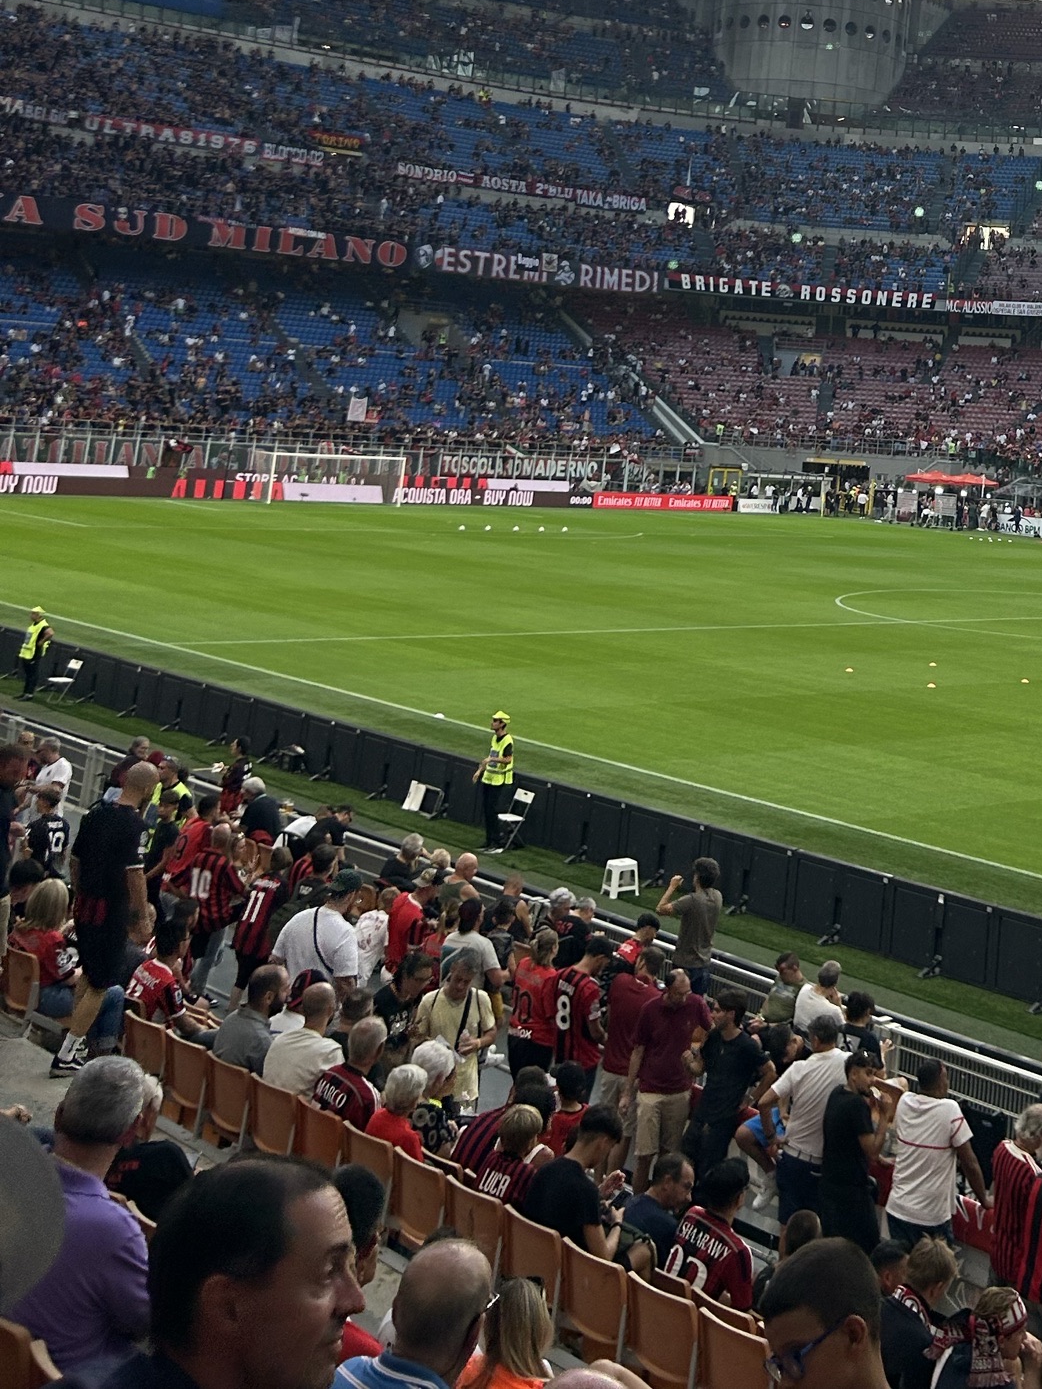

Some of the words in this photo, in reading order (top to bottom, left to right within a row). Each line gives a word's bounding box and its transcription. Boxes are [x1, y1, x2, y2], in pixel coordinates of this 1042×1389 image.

[314, 133, 361, 149] TORINO
[398, 162, 457, 183] SONDRIO
[481, 175, 528, 193] AOSTA
[576, 189, 603, 208] TAKA
[3, 195, 44, 226] A
[73, 203, 188, 242] SUD
[207, 220, 408, 268] MILANO
[680, 273, 772, 298] BRIGATE
[800, 285, 934, 309] ROSSONERE
[962, 301, 993, 315] ALASSIO
[21, 475, 59, 494] NOW
[392, 486, 447, 505] ACQUISTA
[449, 488, 473, 506] ORA
[483, 488, 507, 507] BUY
[508, 490, 534, 507] NOW
[569, 495, 593, 506] 00:00
[597, 495, 633, 507] Emirates
[668, 496, 702, 509] Emirates
[48, 831, 66, 853] 10
[190, 867, 212, 899] 10
[242, 890, 266, 923] 11
[555, 994, 571, 1031] 8
[315, 1078, 348, 1109] MARCO
[479, 1167, 511, 1199] LUCA
[680, 1221, 732, 1262] SHAARAWY
